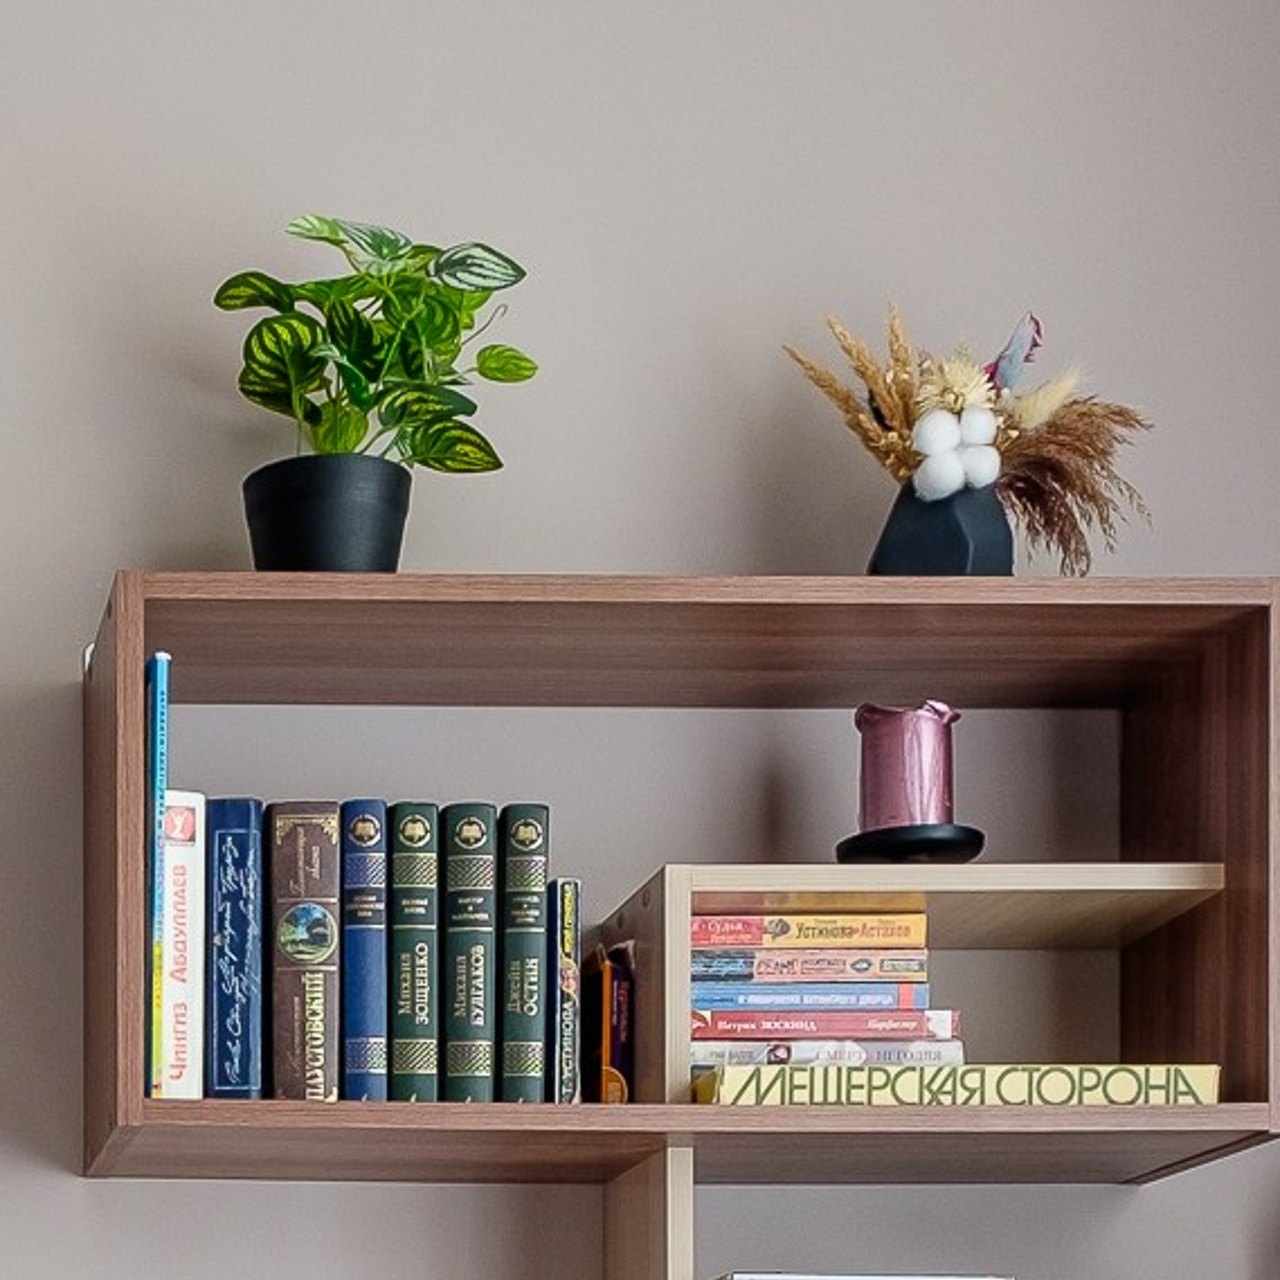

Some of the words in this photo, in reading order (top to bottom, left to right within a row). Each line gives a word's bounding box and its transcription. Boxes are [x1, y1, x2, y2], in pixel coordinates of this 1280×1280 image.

[398, 952, 412, 1014] Михаил
[415, 942, 430, 1025] ЗОЩЕНКО
[454, 955, 467, 1017] Михаил
[470, 944, 485, 1027] БУЛГАКОВ
[301, 970, 325, 1100] ПАУСТОВСКИЙ
[562, 1000, 573, 1078] УСТИНОВА
[731, 1065, 986, 1105] МЕЩЕРСКАЯ
[995, 1065, 1204, 1105] СТОРОНА
